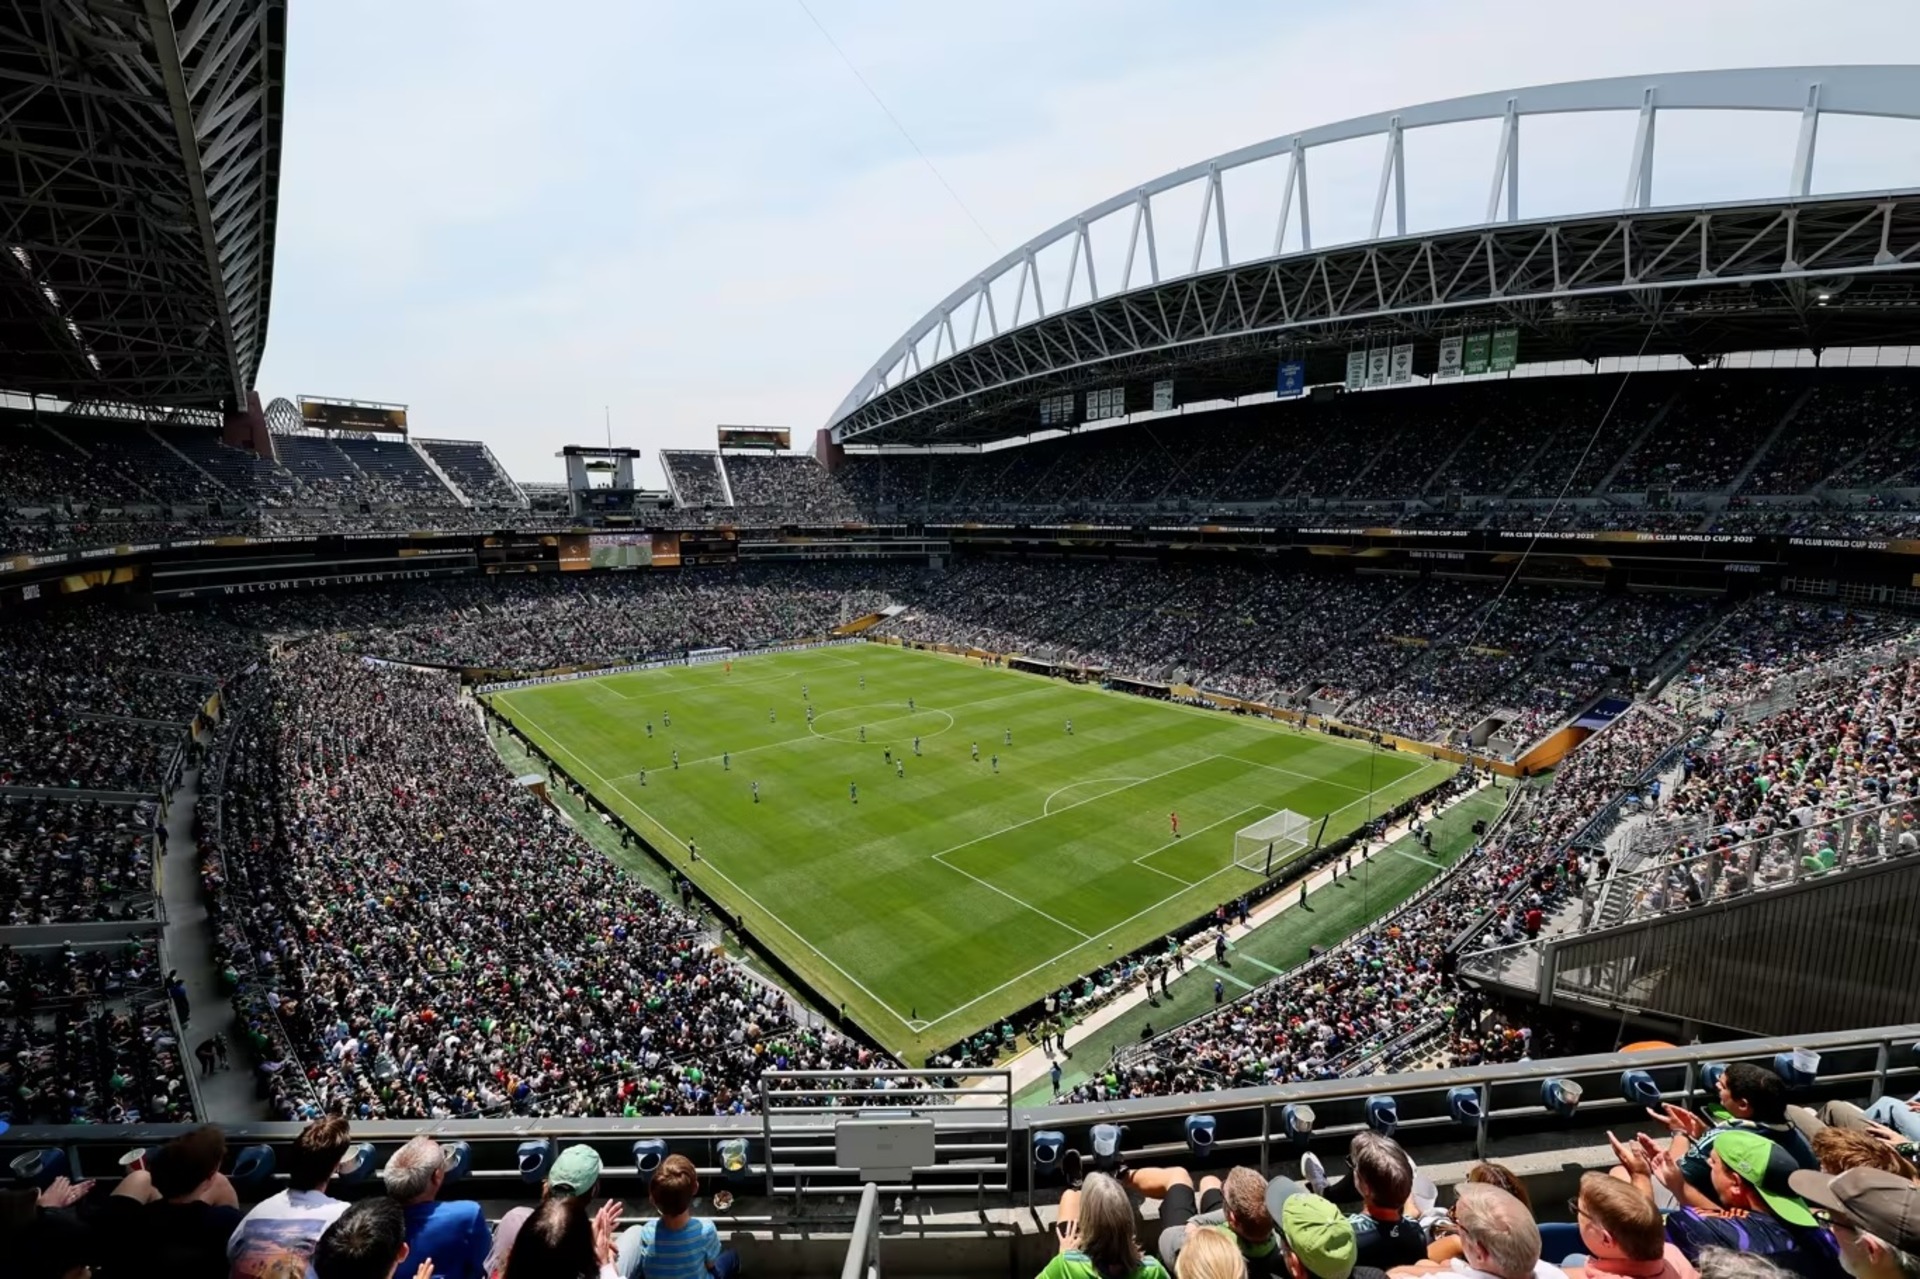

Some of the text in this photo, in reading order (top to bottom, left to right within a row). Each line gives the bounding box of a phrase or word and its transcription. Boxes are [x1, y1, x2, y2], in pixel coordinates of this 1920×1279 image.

[224, 582, 299, 594] WELCOME
[337, 574, 383, 584] LUMEN
[392, 571, 430, 579] FIELD
[577, 670, 599, 679] BANK
[615, 664, 649, 673] AMERICA
[480, 683, 507, 692] BANK
[522, 676, 561, 687] AMERICA
